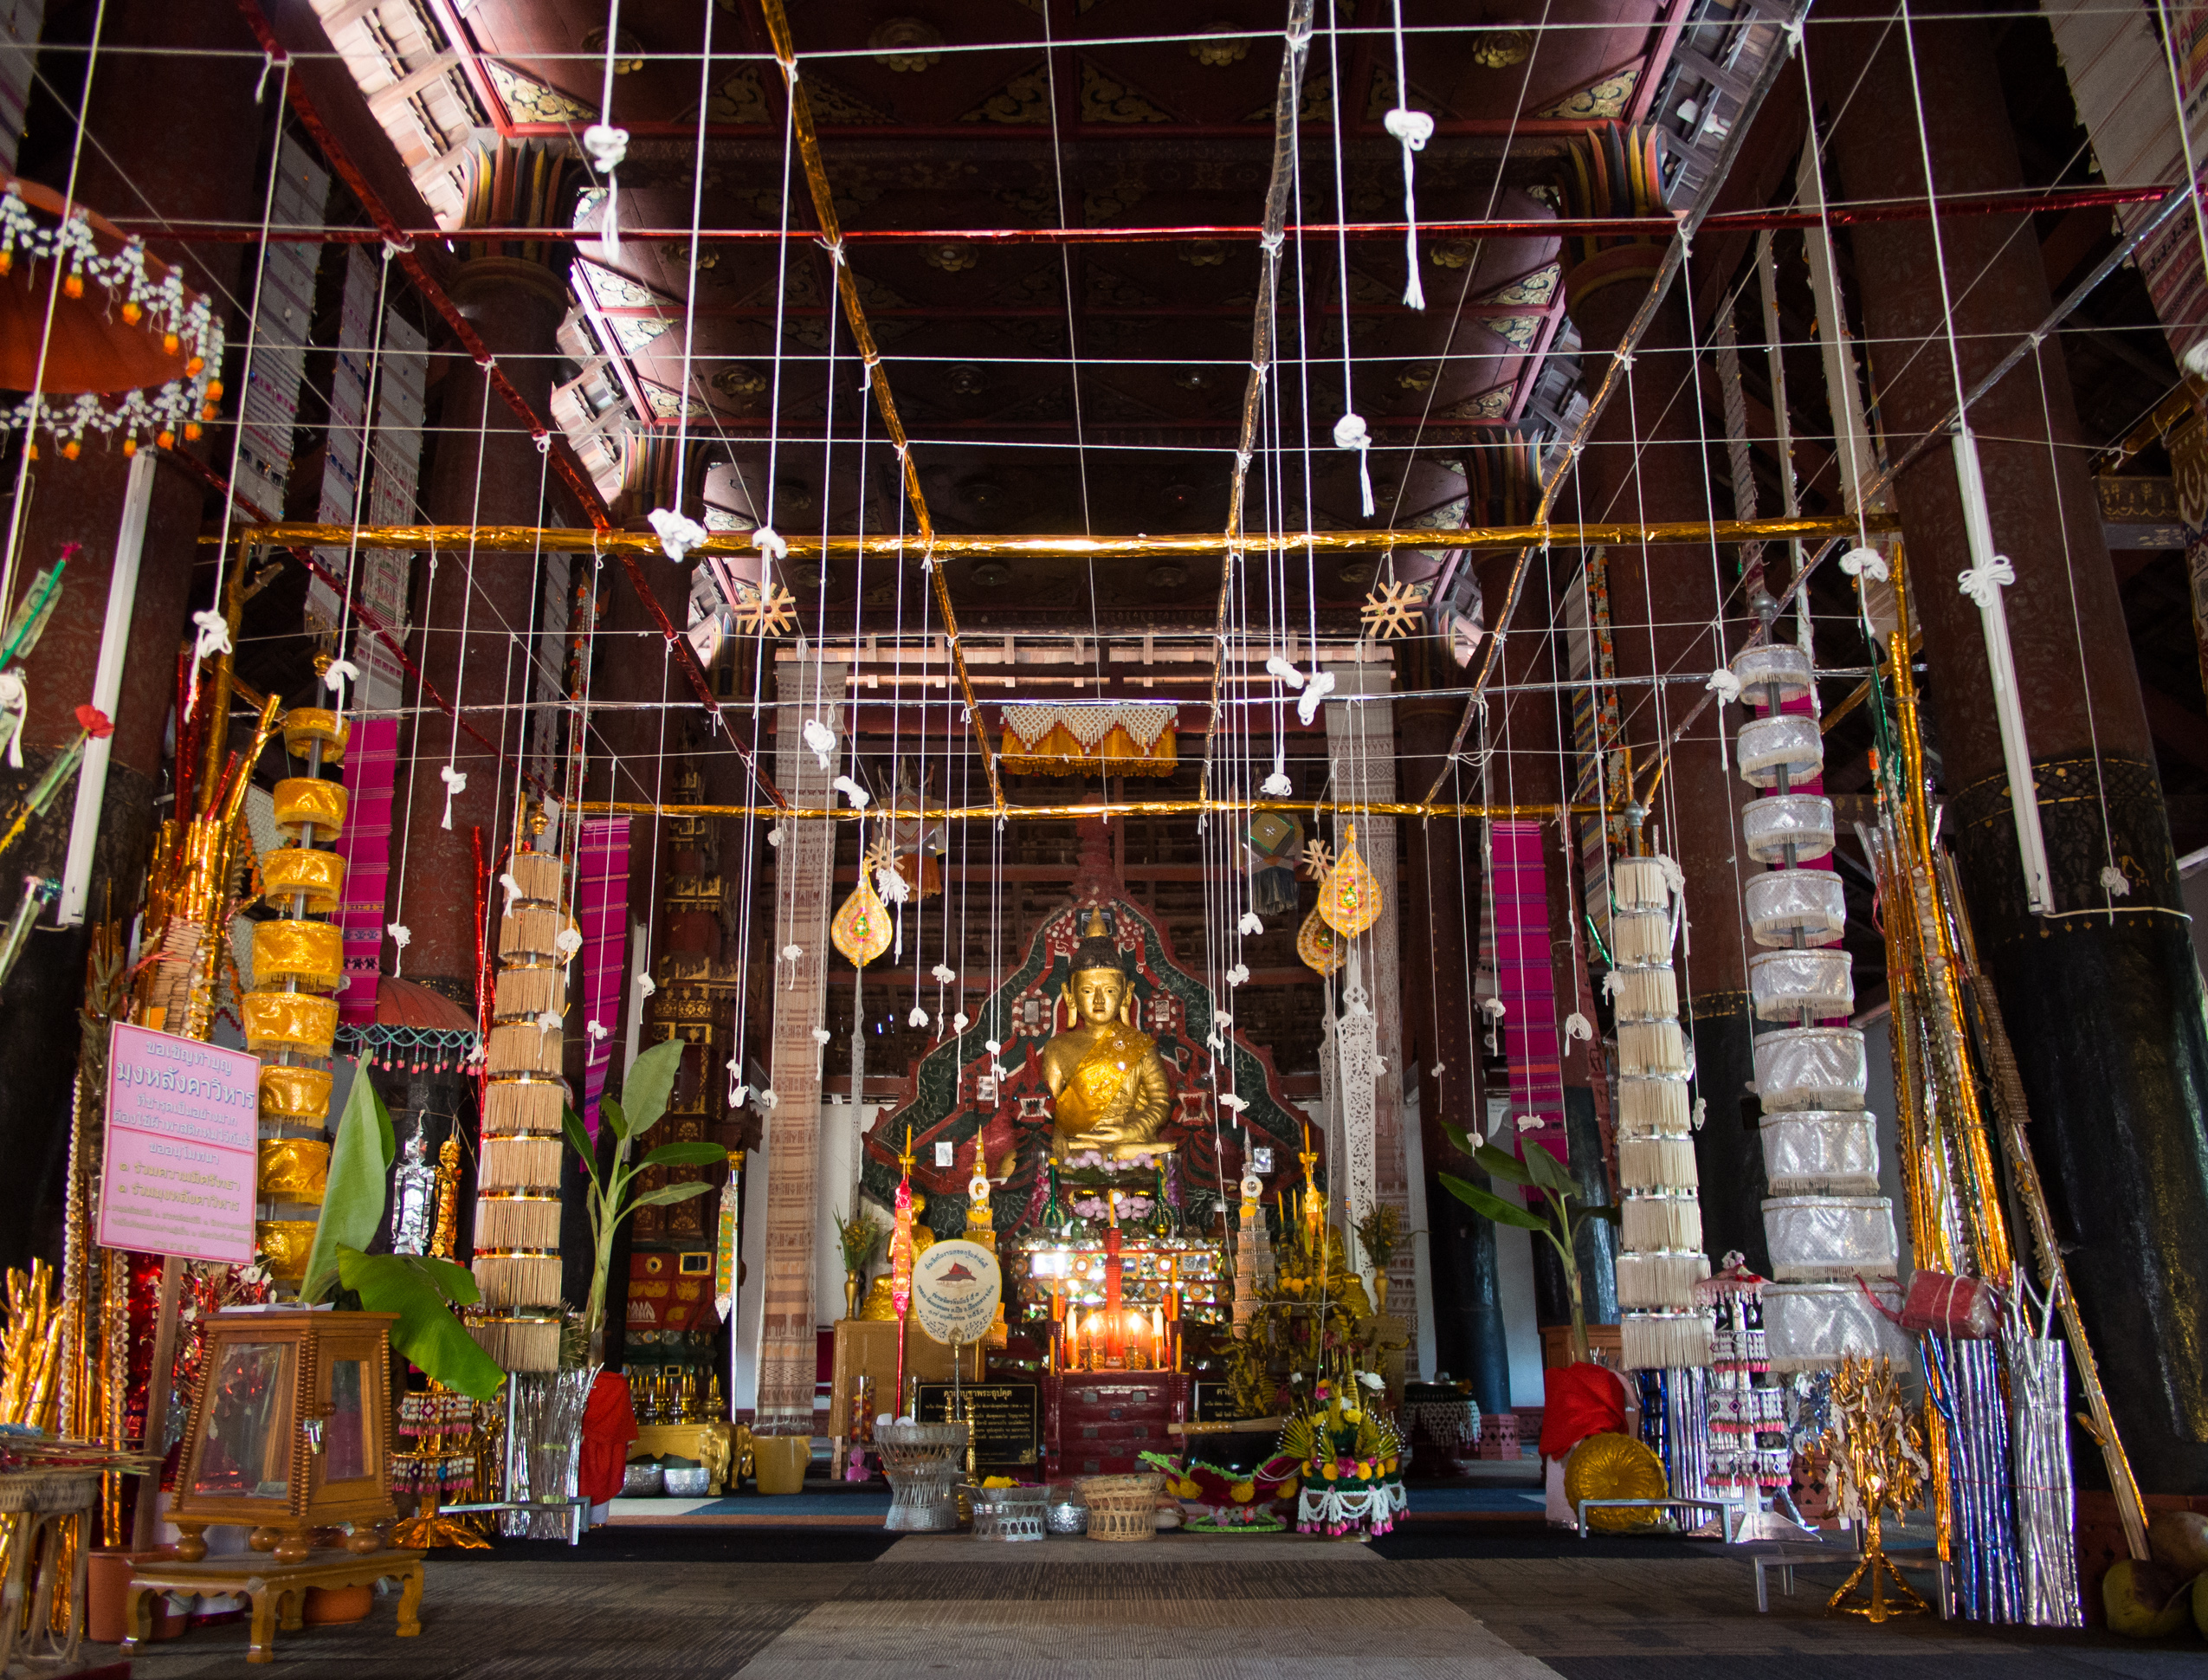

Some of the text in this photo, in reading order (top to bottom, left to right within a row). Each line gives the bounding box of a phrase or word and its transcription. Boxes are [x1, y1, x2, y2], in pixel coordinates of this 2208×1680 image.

[146, 1040, 232, 1076] ขอเชิญทำบุญ
[116, 1062, 255, 1109] มุงหลังคาวิหาร
